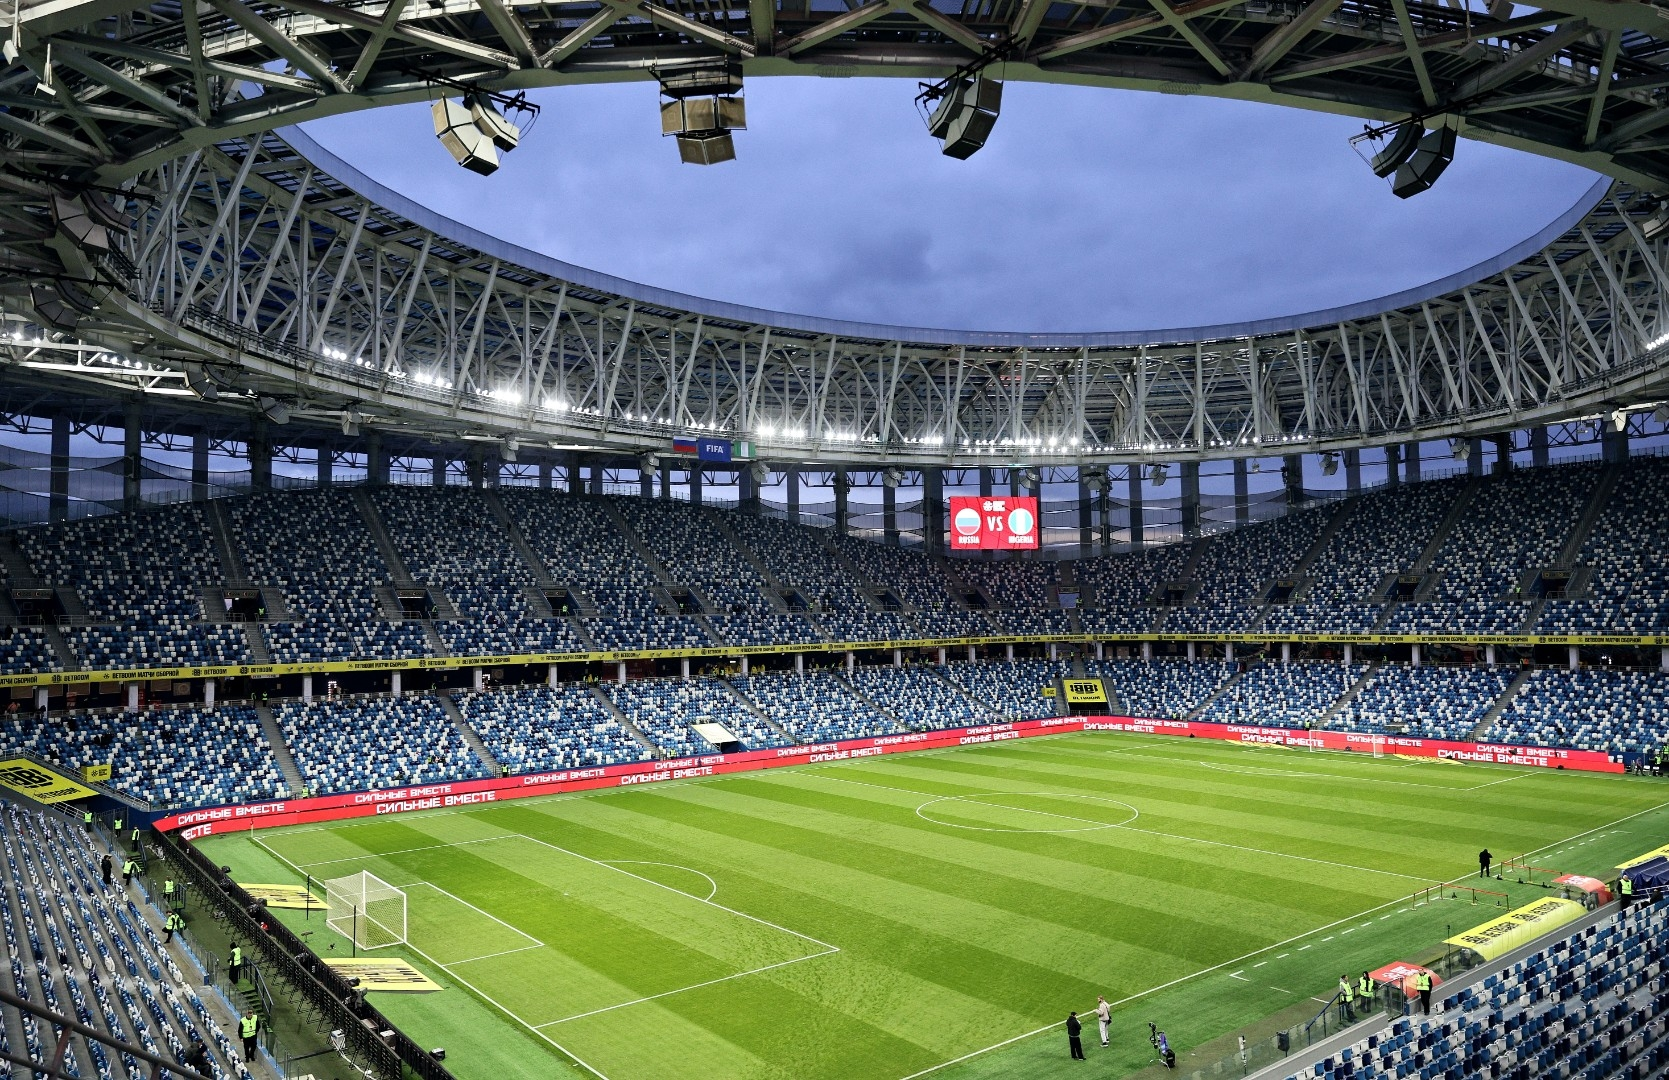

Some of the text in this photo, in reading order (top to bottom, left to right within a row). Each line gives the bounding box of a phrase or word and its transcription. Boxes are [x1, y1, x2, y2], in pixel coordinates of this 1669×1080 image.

[706, 445, 724, 454] FIFA
[986, 516, 1004, 532] VS
[958, 536, 980, 544] RUSSIA
[1008, 536, 1034, 544] NIGERIA
[1040, 718, 1063, 726] СИЛЬНЫЕ
[1124, 724, 1154, 732] ВМЕСТЕ
[966, 724, 1012, 734] СИЛЬНЫЕ ВМЕСТЕ
[1227, 726, 1290, 736] СИЛЬНЫЕ ВМЕСТЕ
[874, 734, 928, 745] СИЛЬНЫЕ ВМЕСТЕ
[960, 731, 1019, 744] СИЛЬНЫЕ ВМЕСТЕ
[1242, 734, 1324, 747] СИЛЬНЫЕ ВМЕСТЕ
[1346, 735, 1422, 746] СИЛЬНЫЕ ВМЕСТЕ
[778, 744, 838, 756] СИЛЬНЫЕ ВМЕСТЕ
[810, 747, 882, 762] СИЛЬНЫЕ ВМЕСТЕ
[1476, 744, 1568, 758] СИЛЬНЕ ВМЕСТЕ
[1438, 750, 1548, 766] СИЛЬНЫЕ ВМЕСТЕ
[655, 760, 692, 770] СИЛЬНЫЕ
[524, 769, 605, 784] СИЛЬНЫЕ ВМЕСТЕ
[621, 766, 712, 784] СИЛЬНЫЕ ВМЕСТЕ
[354, 785, 452, 803] СИЛЬНЫЕ ВМЕСТЕ
[376, 791, 496, 814] СИЛЬНЫЕ ВМЕСТЕ
[178, 803, 285, 825] СИЛЬНЫЕ ВМЕСТЕ
